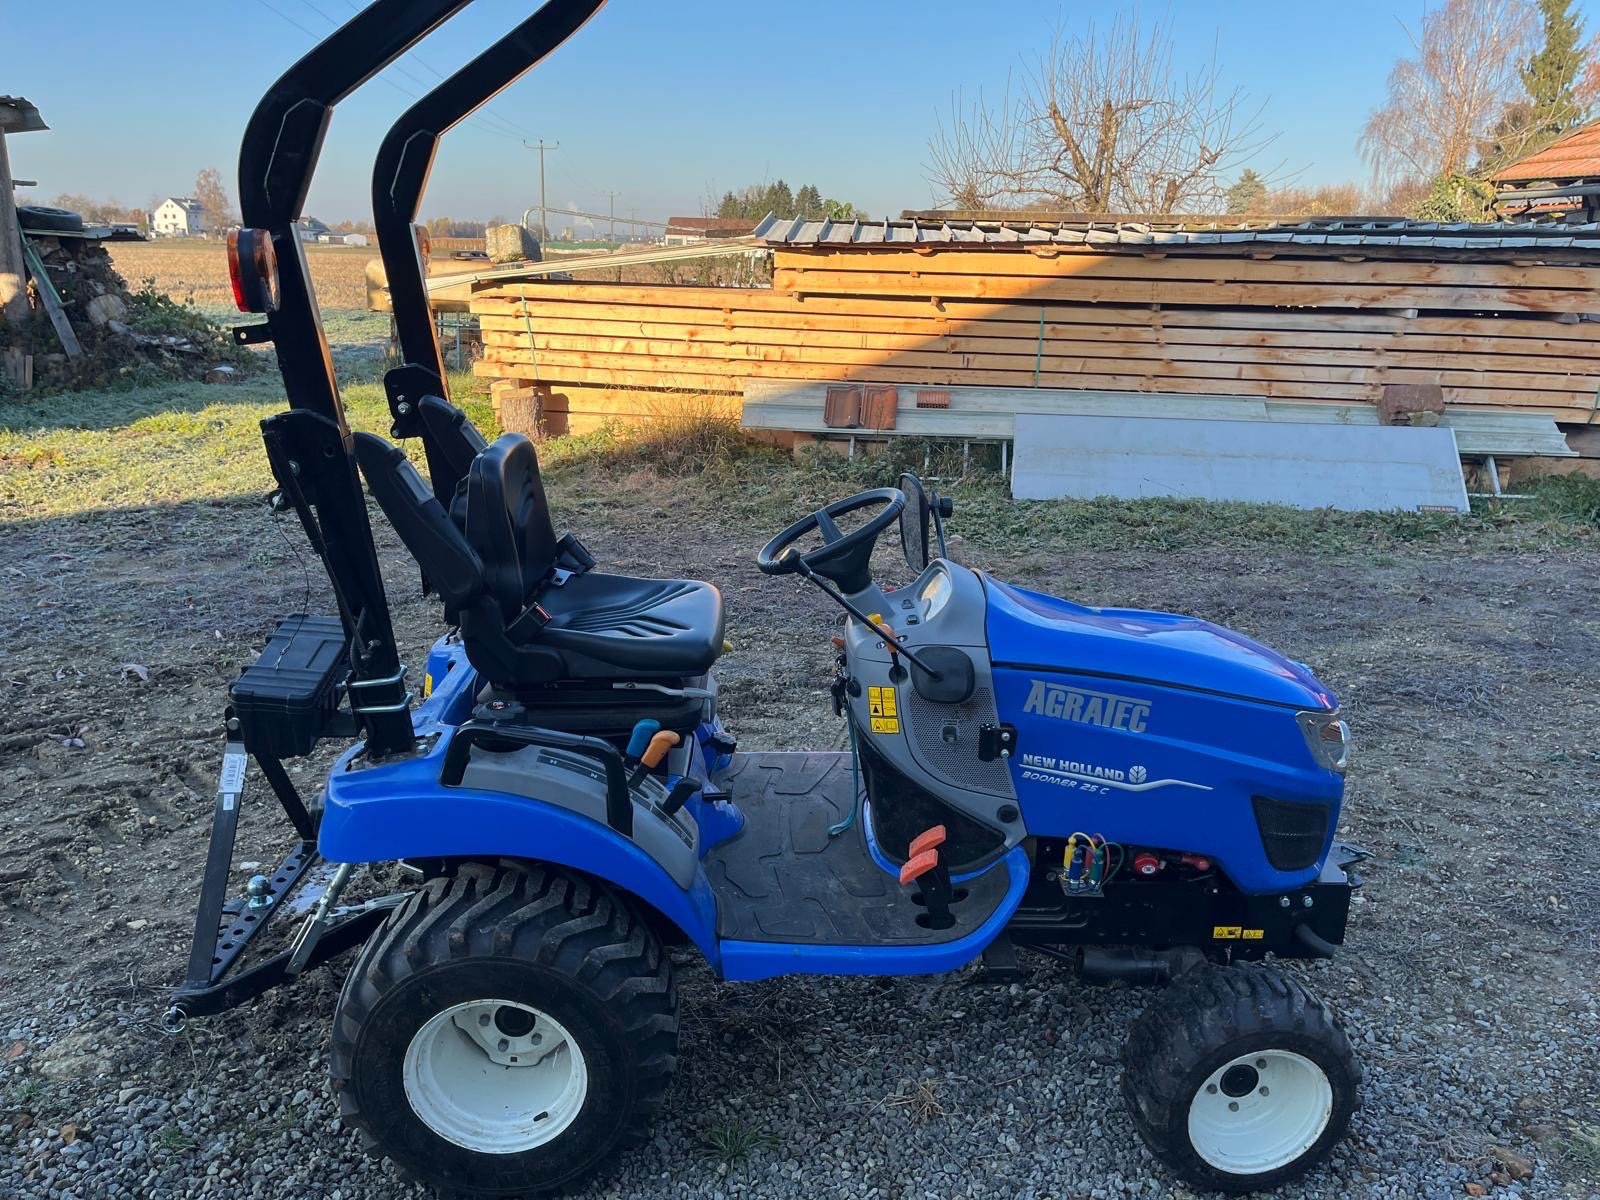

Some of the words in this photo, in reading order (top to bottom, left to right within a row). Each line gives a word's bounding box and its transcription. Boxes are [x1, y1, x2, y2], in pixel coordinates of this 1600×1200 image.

[1023, 679, 1152, 733] AGRATEC
[1023, 753, 1056, 768] NEW
[1059, 759, 1125, 781] HOLLAND
[1021, 770, 1078, 788] BOOMER
[1080, 783, 1099, 793] 25
[1100, 787, 1111, 796] C
